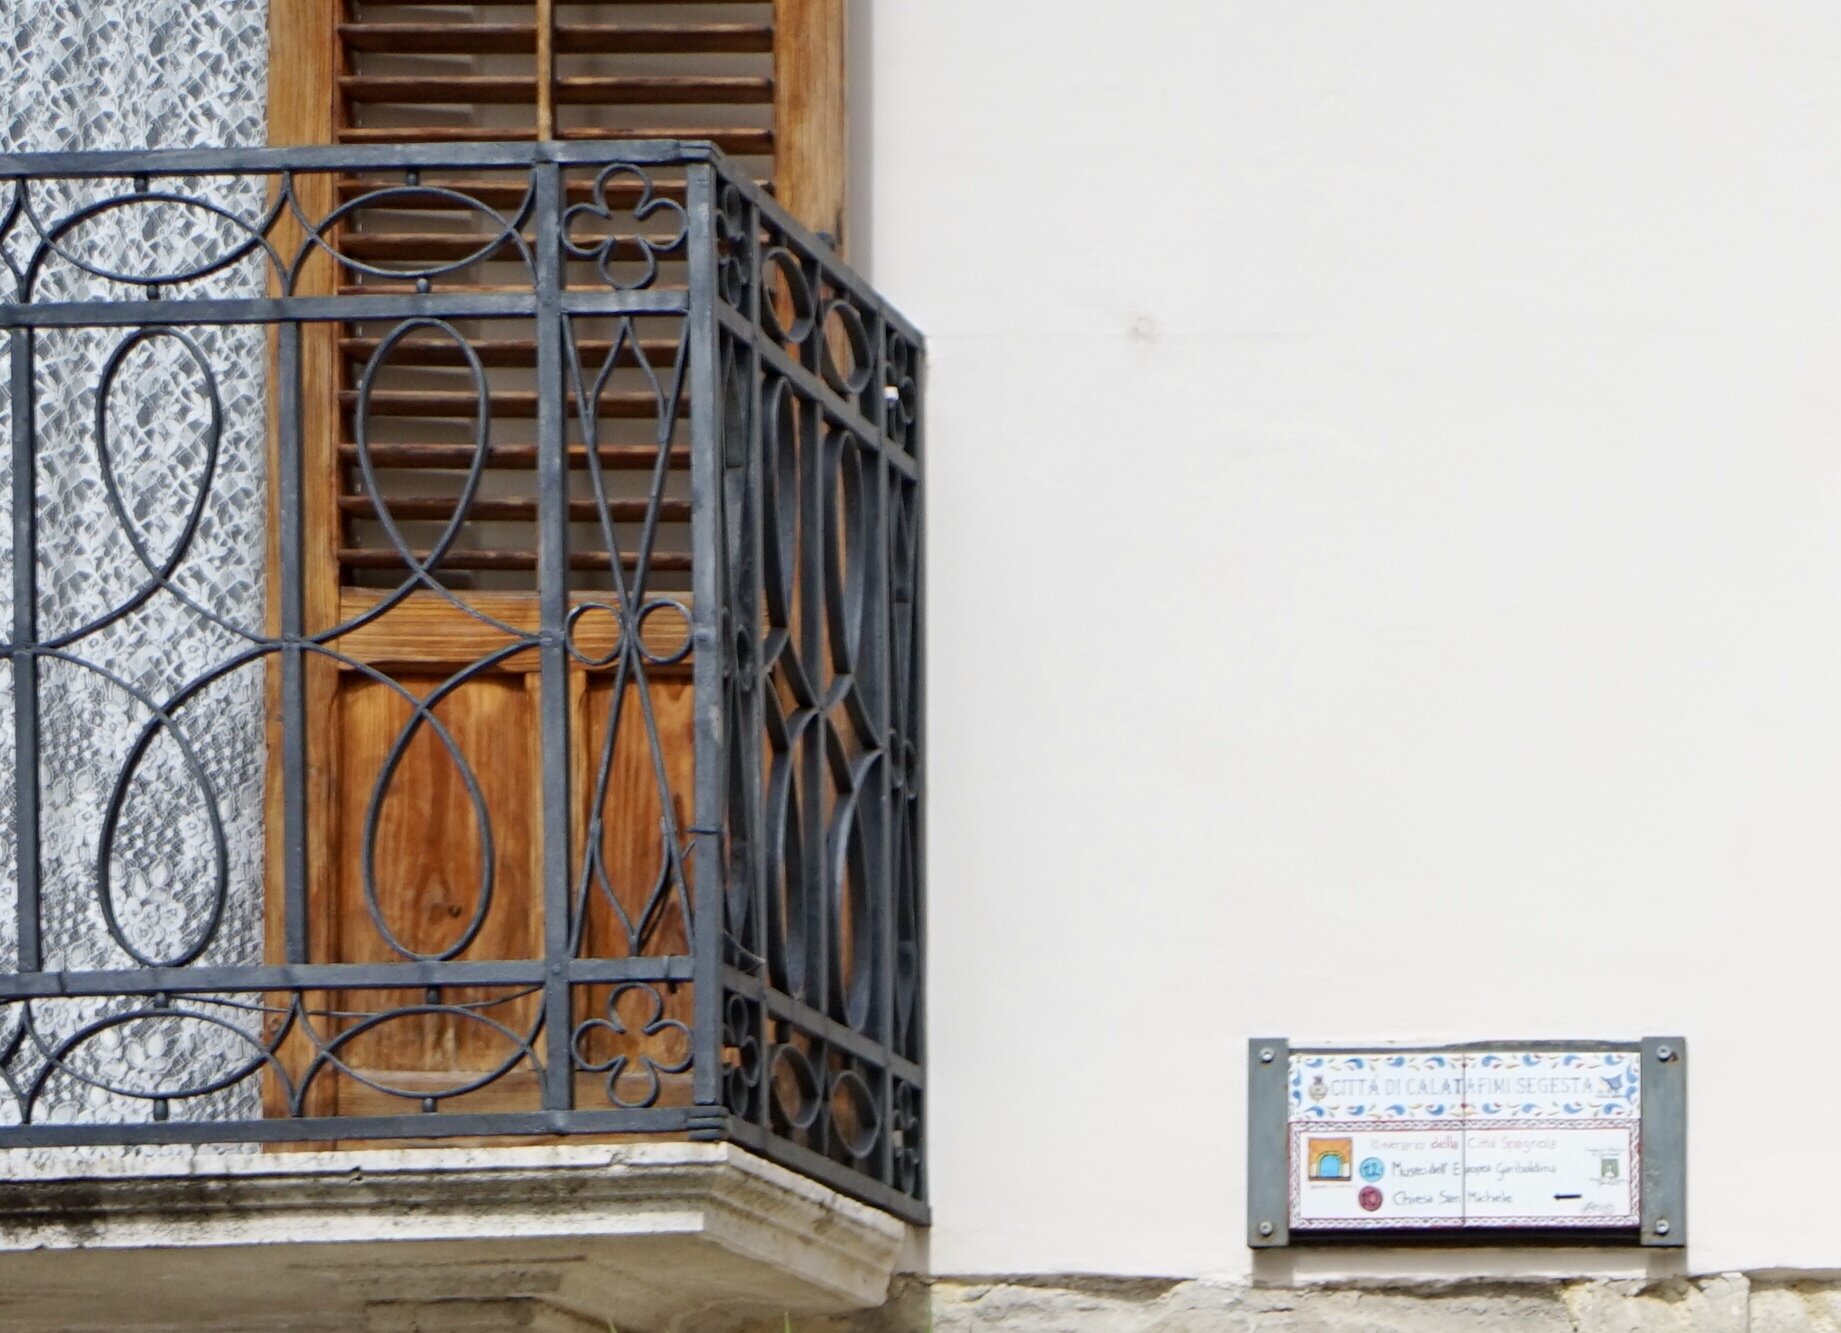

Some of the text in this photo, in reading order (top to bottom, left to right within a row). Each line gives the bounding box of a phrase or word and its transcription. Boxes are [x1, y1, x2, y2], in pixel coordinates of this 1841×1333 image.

[1385, 1078, 1401, 1096] DI
[1405, 1077, 1511, 1096] CALATAFIMI
[1516, 1076, 1593, 1095] SEGESTA
